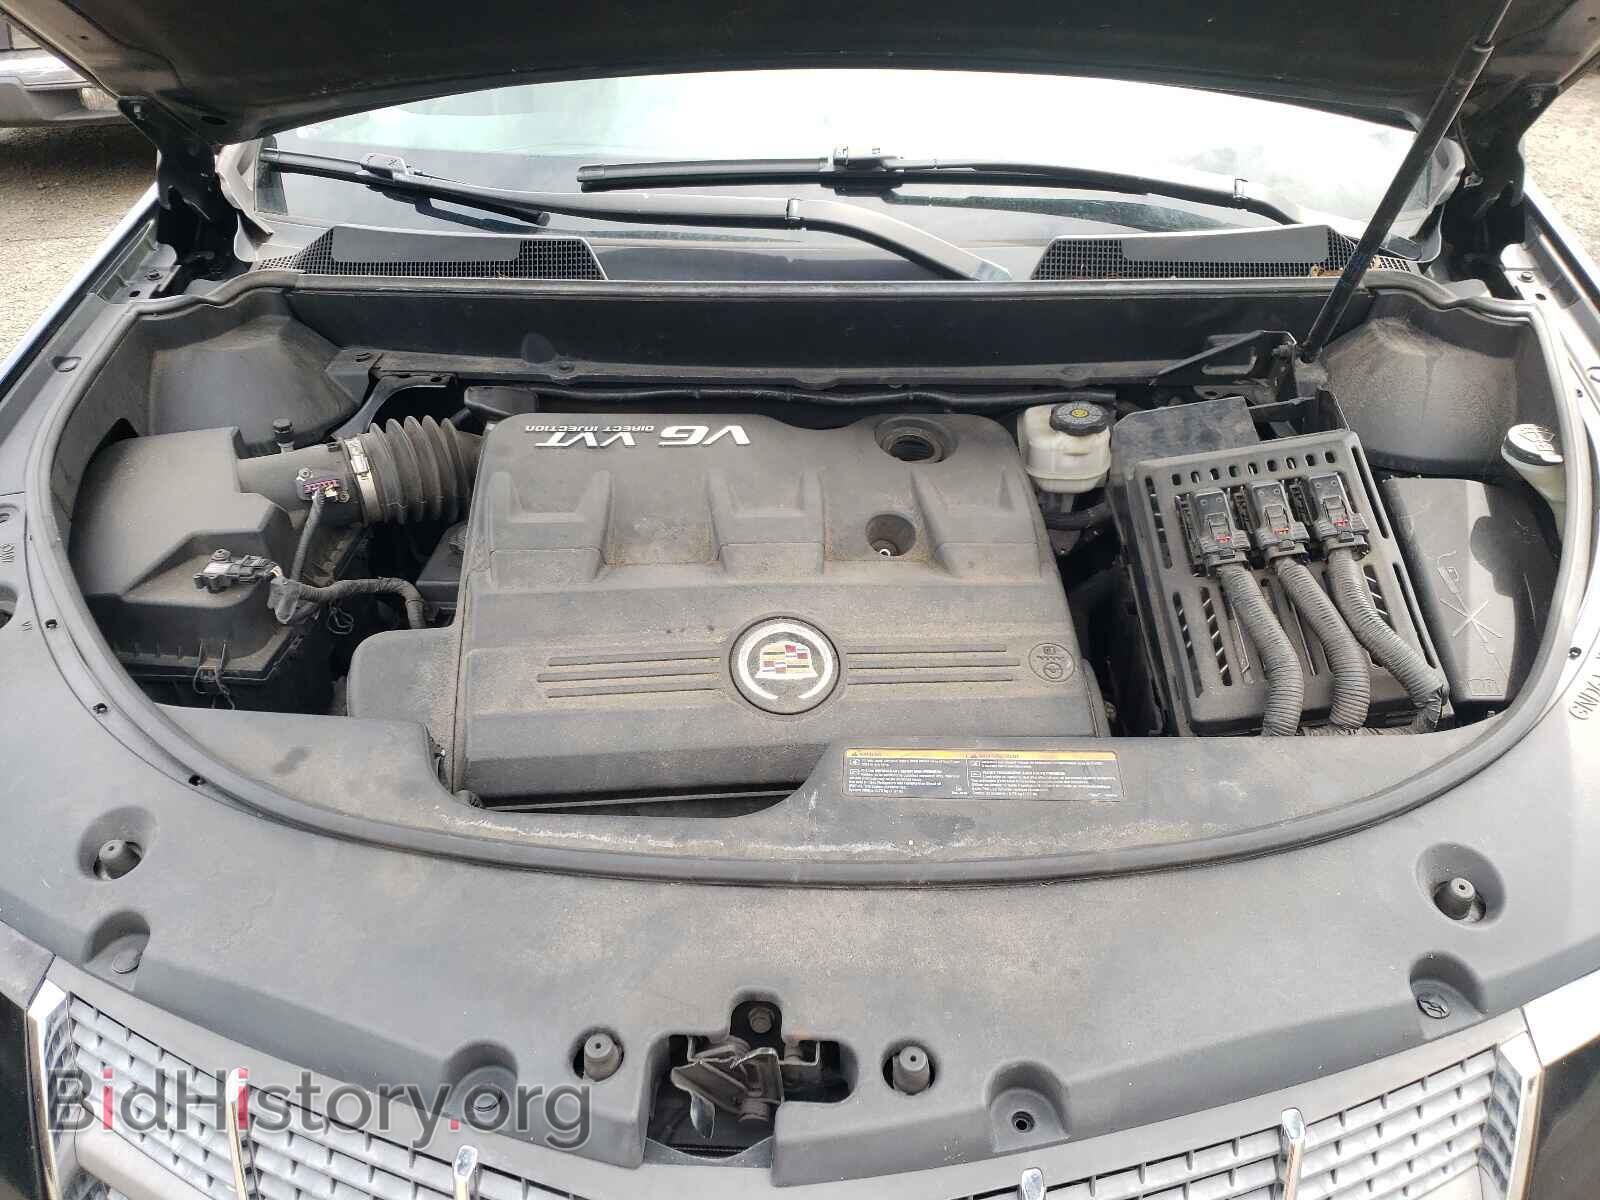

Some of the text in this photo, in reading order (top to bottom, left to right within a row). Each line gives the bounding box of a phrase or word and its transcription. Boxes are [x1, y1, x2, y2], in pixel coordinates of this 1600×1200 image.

[524, 424, 655, 432] DIRECT INJECTION
[535, 424, 751, 448] V6 VVT
